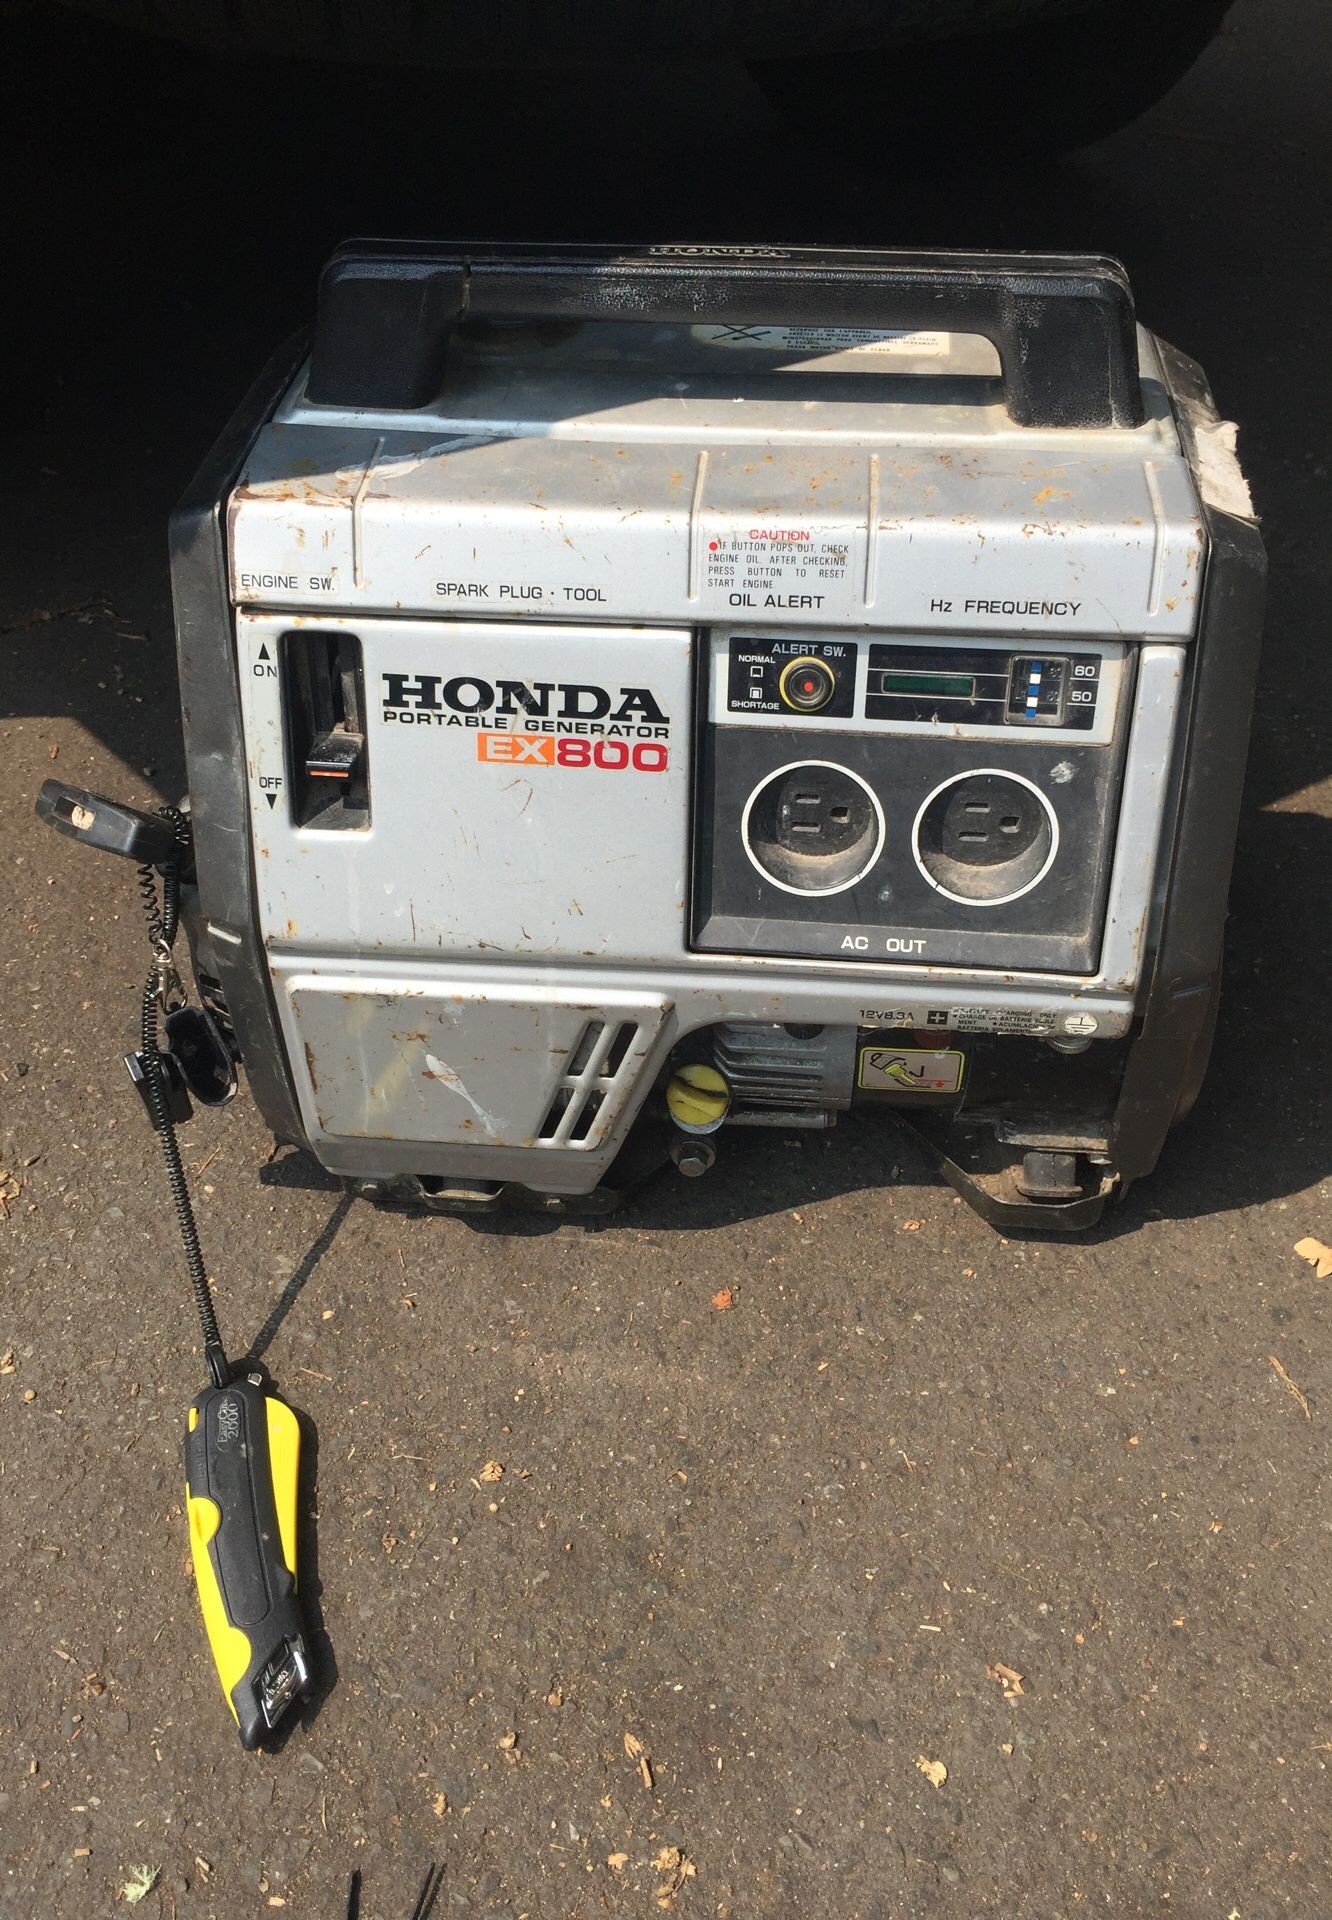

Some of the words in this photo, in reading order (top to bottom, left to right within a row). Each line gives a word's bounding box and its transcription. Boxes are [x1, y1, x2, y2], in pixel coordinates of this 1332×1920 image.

[650, 247, 791, 258] HONDA
[749, 529, 810, 541] CAUTION
[719, 541, 727, 550] IF
[731, 541, 766, 551] BUTTON
[770, 543, 793, 553] POPS
[821, 544, 849, 554] CHECK
[708, 554, 739, 563] ENGINE
[769, 555, 796, 565] AFTER
[708, 566, 735, 576] PRESS
[747, 567, 782, 577] BUTTON
[795, 568, 806, 578] TO
[241, 574, 299, 589] ENGINE
[309, 577, 335, 591] SW.
[708, 578, 735, 588] START
[436, 582, 489, 598] SPARK
[499, 585, 543, 599] PLUG
[563, 587, 607, 602] TOOL
[729, 593, 757, 607] OIL
[764, 594, 825, 609] ALERT
[930, 599, 953, 613] Hz
[964, 599, 1082, 616] FREQUENCY
[771, 643, 818, 655] ALERT
[823, 645, 847, 657] SW.
[738, 654, 776, 664] NORMAL
[253, 664, 278, 678] ON
[1074, 665, 1096, 677] 60
[382, 673, 671, 724] HONDA
[1071, 690, 1092, 702] 50
[731, 700, 780, 711] SHORTAGE
[383, 710, 508, 730] PORTABLE
[524, 718, 670, 739] GENERATOR
[485, 734, 668, 772] EX800
[259, 776, 283, 790] OFF
[840, 935, 869, 950] AC
[886, 938, 927, 954] OUT
[859, 1009, 915, 1021] 12V8.3A
[227, 1403, 239, 1440] 2000
